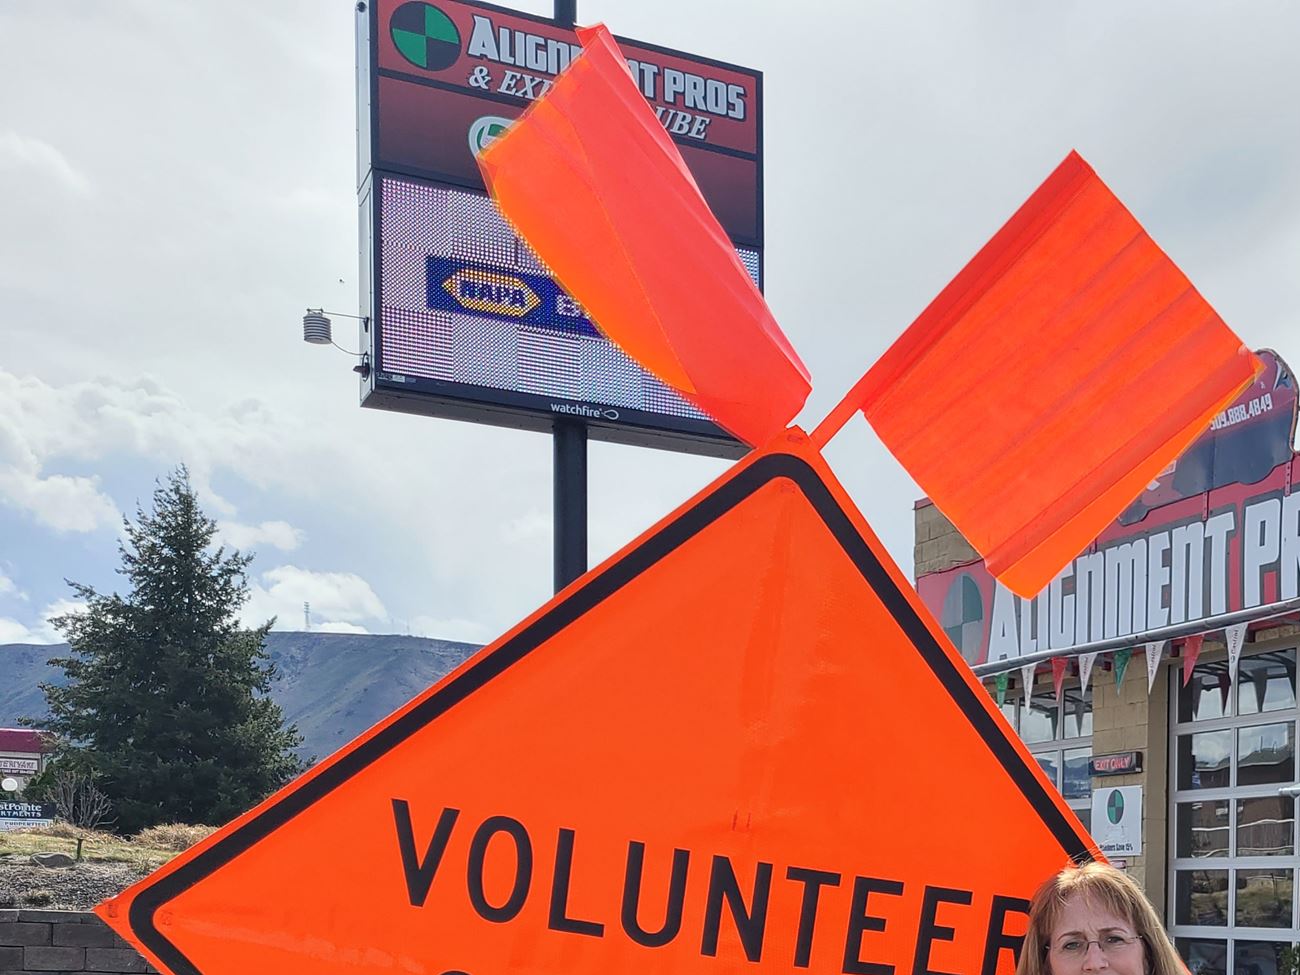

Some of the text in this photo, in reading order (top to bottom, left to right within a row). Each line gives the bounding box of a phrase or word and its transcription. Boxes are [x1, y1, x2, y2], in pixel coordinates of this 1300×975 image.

[468, 15, 658, 98] ALIGNT
[664, 67, 745, 120] PROS
[468, 66, 491, 90] &
[656, 106, 711, 140] UBE
[550, 403, 601, 418] watchfire
[987, 512, 1236, 664] ALIGNMENT
